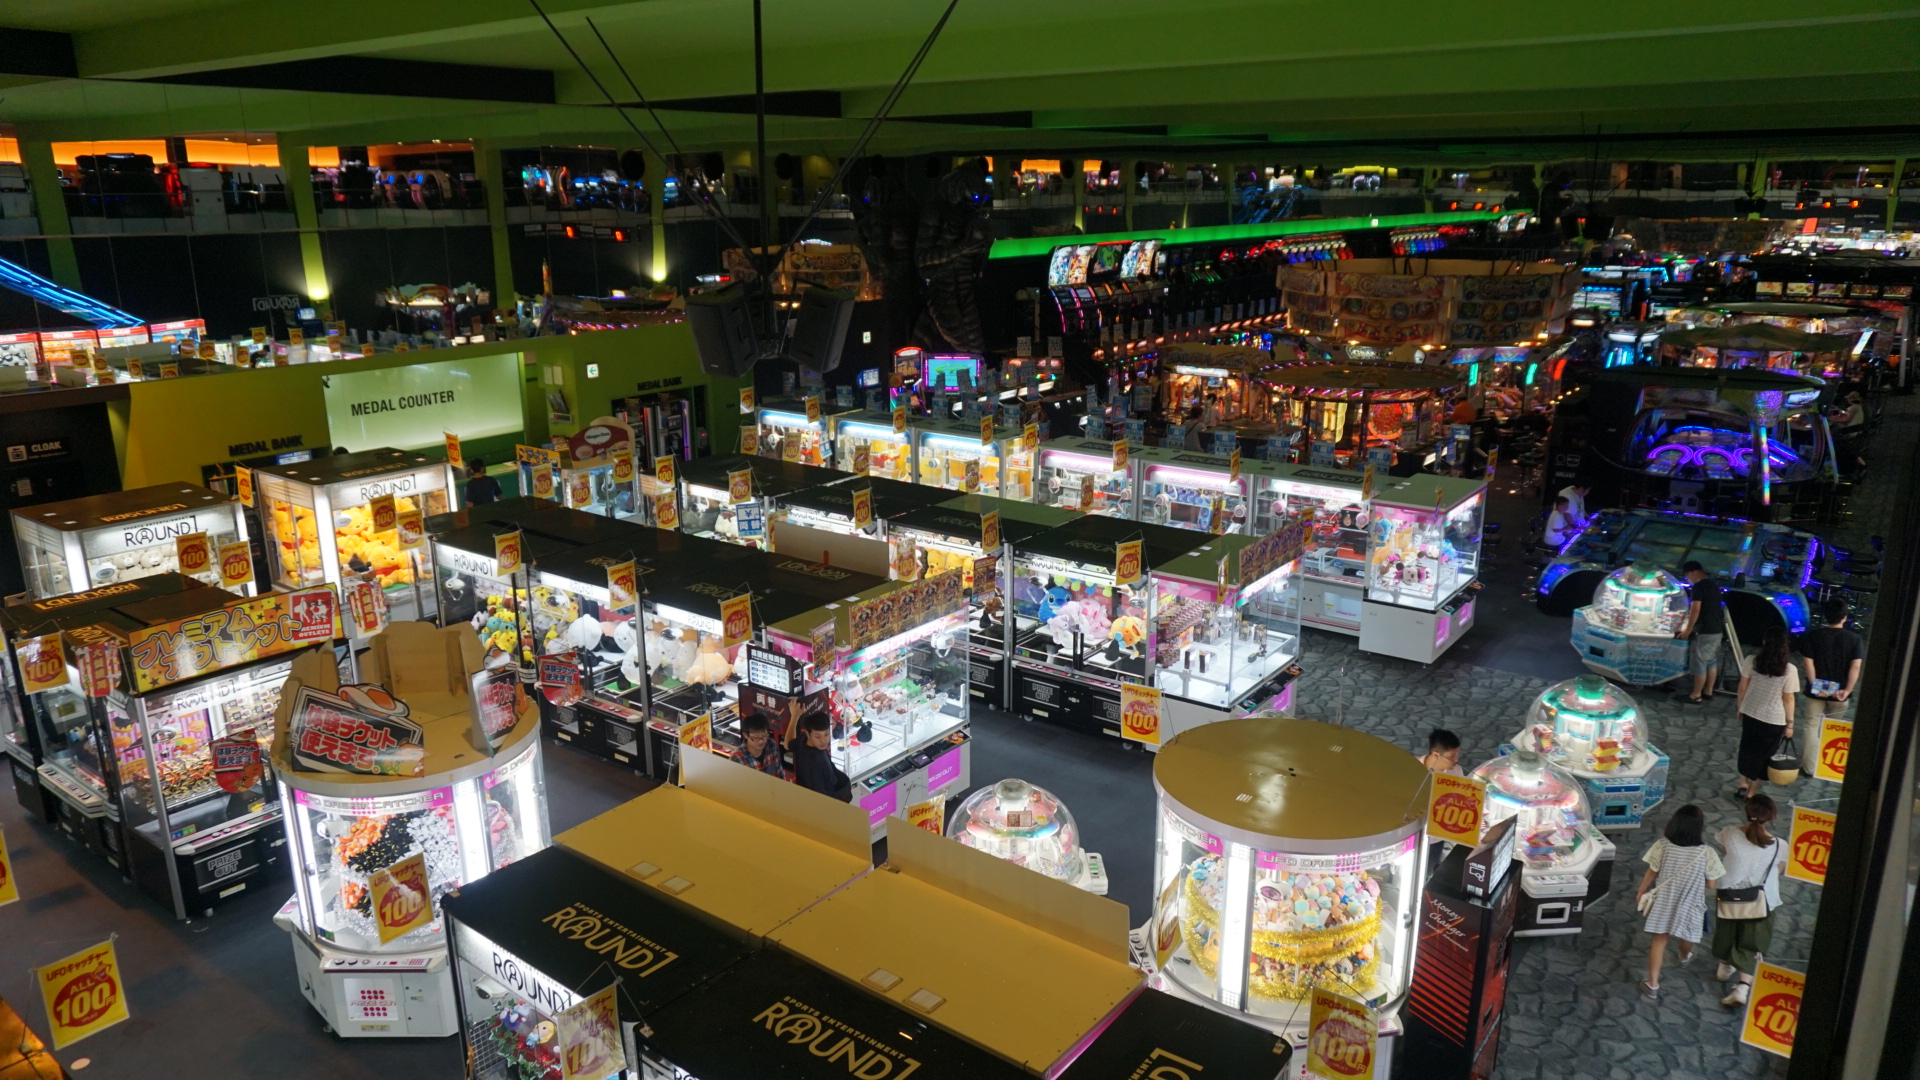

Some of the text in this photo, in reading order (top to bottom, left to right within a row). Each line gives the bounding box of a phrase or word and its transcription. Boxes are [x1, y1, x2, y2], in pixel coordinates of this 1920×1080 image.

[351, 390, 455, 417] MEDAL COUNTER
[31, 441, 62, 453] CLOAK
[228, 435, 304, 457] MEDAL BANK
[360, 474, 417, 500] ROUND1
[124, 514, 199, 547] ROUND1
[454, 554, 493, 577] ROUND1
[132, 608, 255, 669] プレミアム
[298, 629, 331, 638] OUTLETS
[301, 623, 331, 632] REMIUM
[160, 614, 303, 681] アウトレット
[1032, 683, 1053, 696] PRIZE
[1035, 691, 1051, 701] OUT
[1103, 702, 1121, 713] PRIZ
[301, 728, 380, 774] 使えます。
[1837, 741, 1850, 749] AL
[1824, 747, 1849, 767] 10
[1436, 778, 1483, 792] UFOキャッチャー
[369, 792, 445, 810] CATCHER
[1448, 797, 1466, 807] ALL
[1433, 804, 1475, 831] 100円
[208, 849, 242, 871] PRIZE
[214, 861, 239, 878] OUT
[1264, 854, 1297, 867] UFO
[1300, 857, 1355, 869] DREAM
[1430, 898, 1461, 921] Money
[574, 902, 668, 953] SPORTS ENTERTAINMENT
[1429, 912, 1467, 937] Changer
[541, 906, 680, 978] ROUND1
[46, 951, 110, 982] UFOキャッチャー
[70, 979, 95, 995] ALL
[492, 951, 572, 1013] ROUND1
[56, 982, 116, 1028] 100円
[782, 995, 906, 1060] SPORTS ENTERTAINMENT
[1756, 1005, 1797, 1038] 10
[752, 1001, 922, 1080] ROUND1
[1314, 1031, 1368, 1075] 100円
